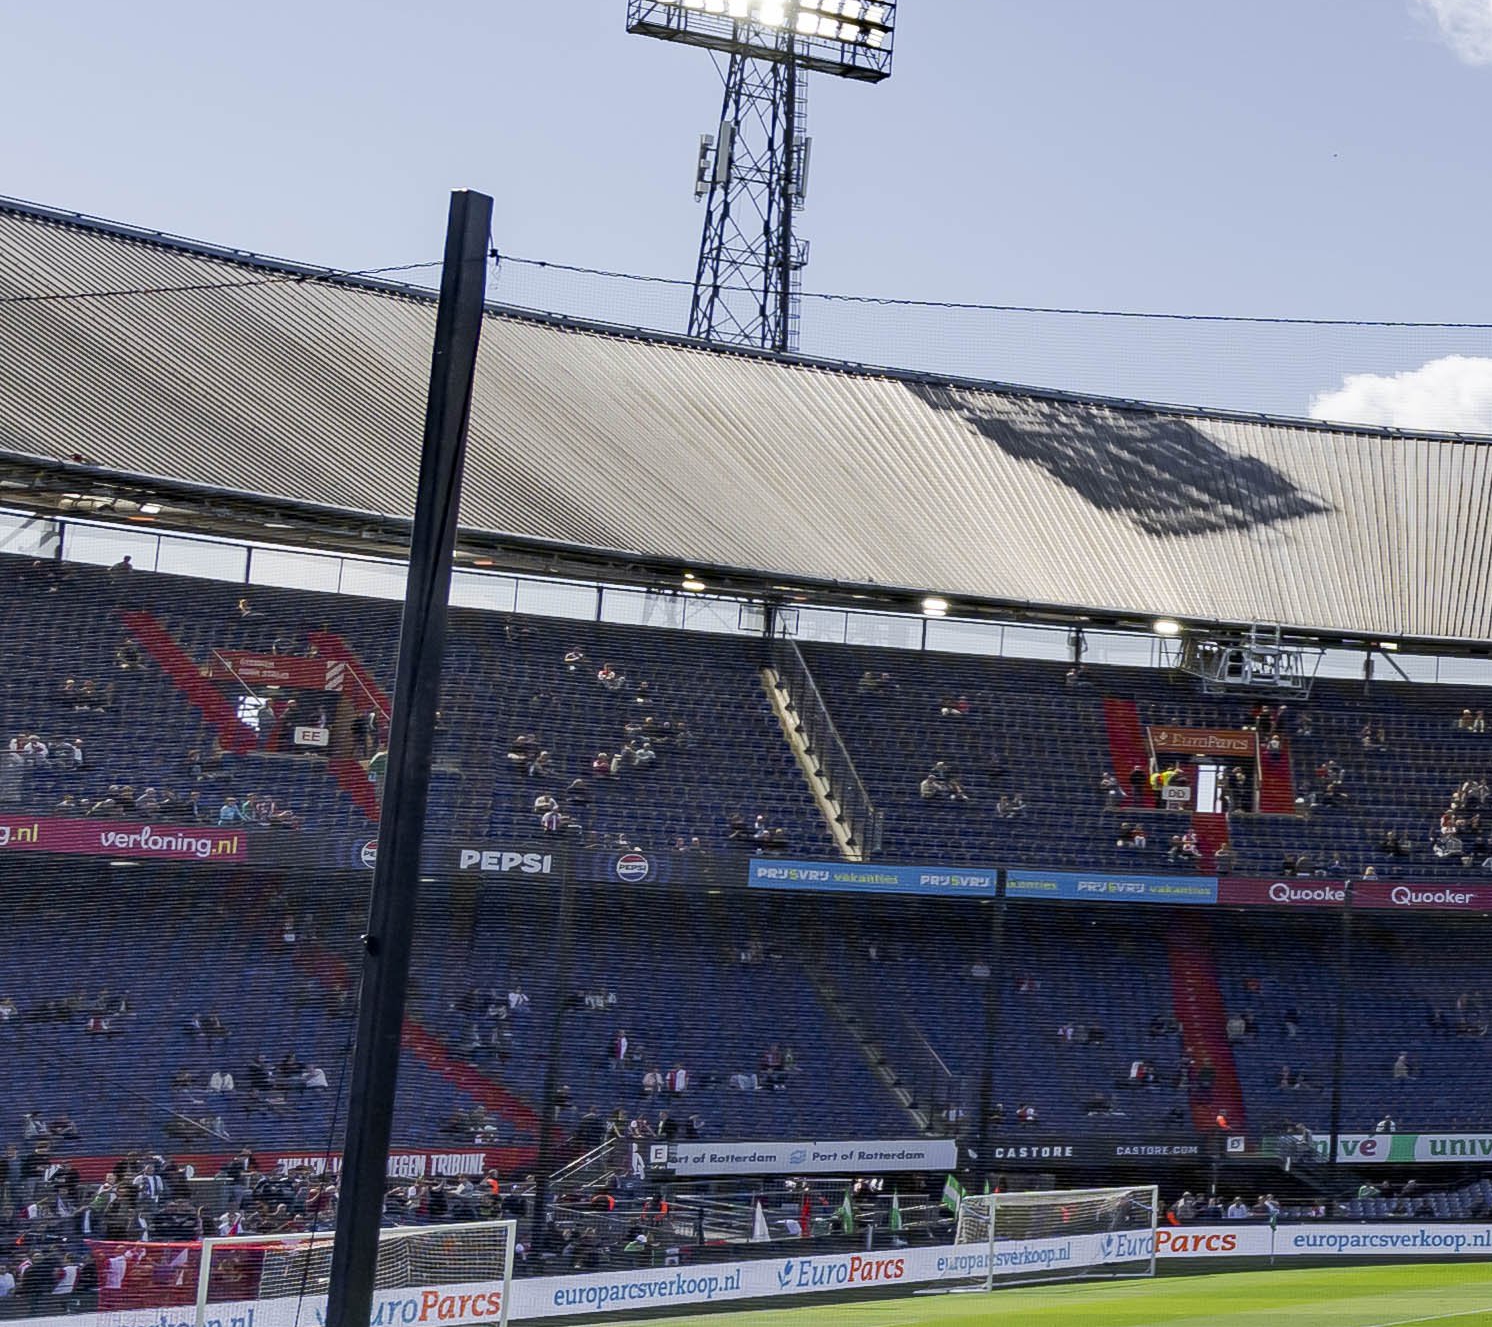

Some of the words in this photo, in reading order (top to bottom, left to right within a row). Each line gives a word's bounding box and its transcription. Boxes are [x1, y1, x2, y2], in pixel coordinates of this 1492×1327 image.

[301, 730, 321, 742] EE
[100, 826, 238, 857] verloning.nl
[459, 848, 552, 874] PEPSI
[618, 863, 648, 872] PEPSI
[1268, 882, 1345, 903] Quooke
[1391, 886, 1474, 906] Quooker
[653, 1147, 664, 1159] E
[670, 1153, 689, 1163] ort
[692, 1152, 706, 1163] of
[709, 1151, 777, 1163] Rotterdam
[811, 1150, 838, 1162] Port
[840, 1150, 856, 1162] of
[858, 1149, 925, 1161] Rotterdam
[995, 1146, 1073, 1158] CASTORE
[430, 1152, 487, 1177] TRIBUNE
[1116, 1230, 1237, 1262] EuroParcs
[1293, 1229, 1492, 1252] europarcsverkoop.nl
[797, 1255, 905, 1288] EuroParcs
[554, 1268, 741, 1308] europarcsverkoop.nl
[370, 1290, 502, 1323] uroParcs
